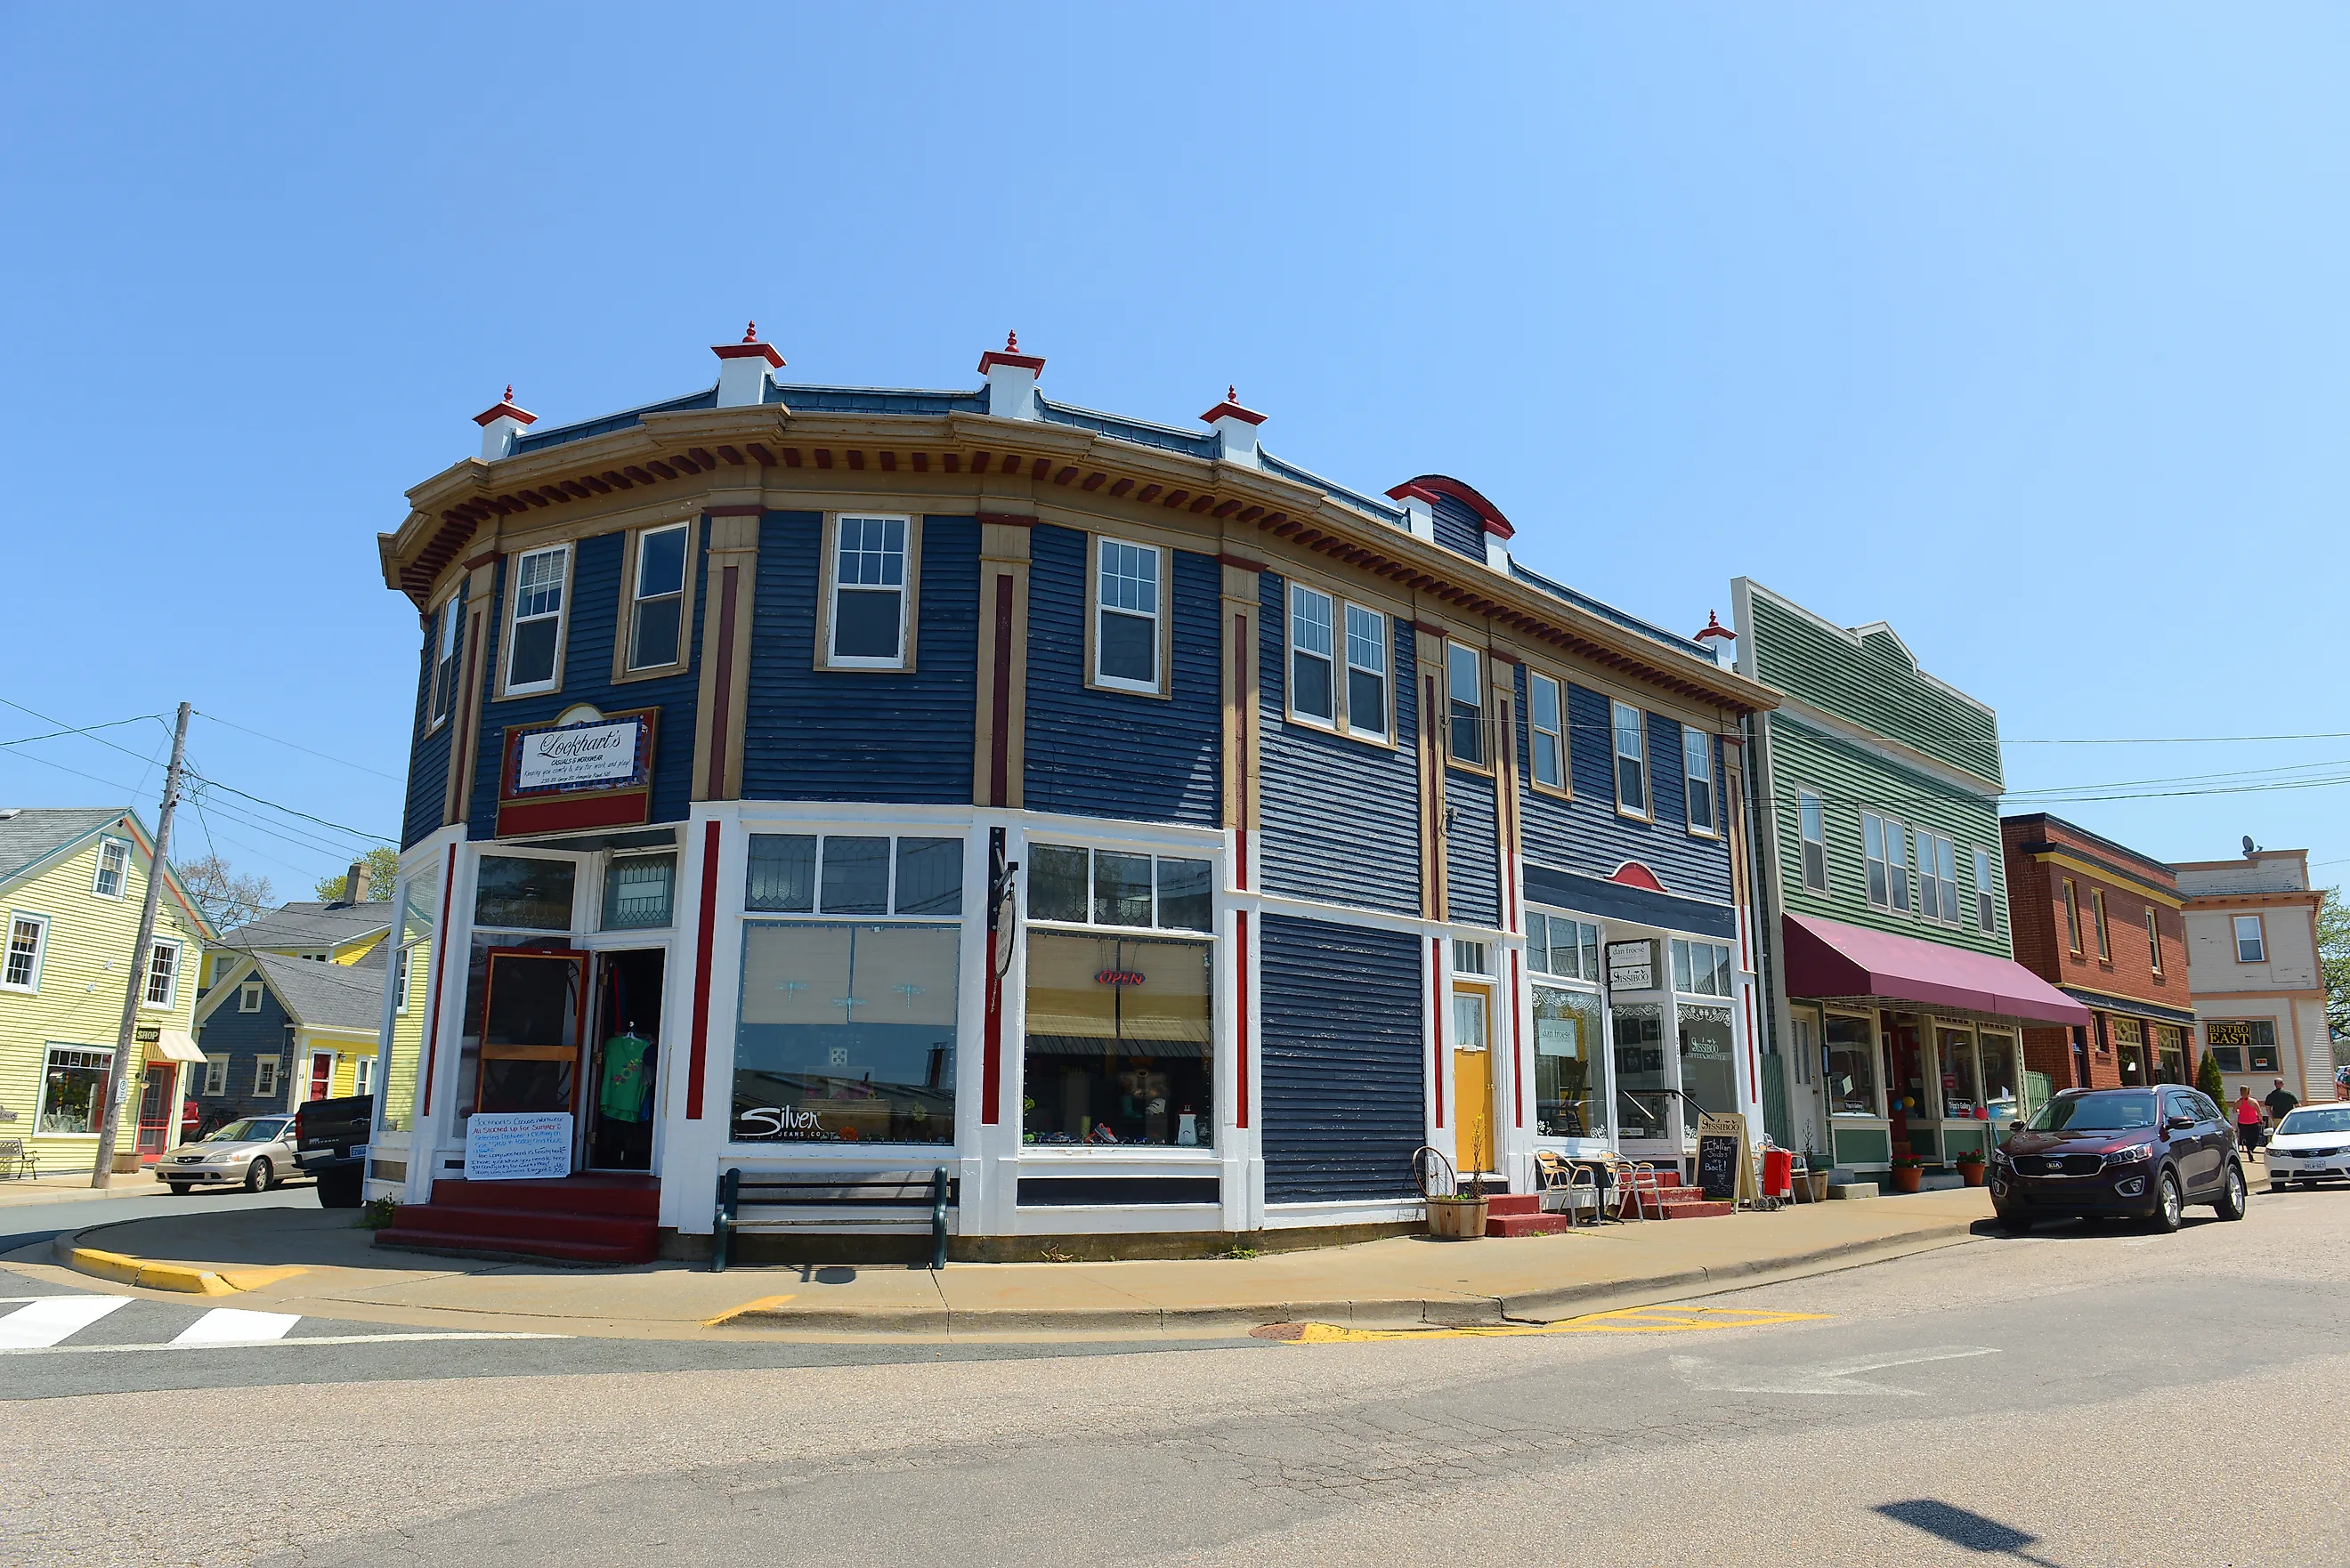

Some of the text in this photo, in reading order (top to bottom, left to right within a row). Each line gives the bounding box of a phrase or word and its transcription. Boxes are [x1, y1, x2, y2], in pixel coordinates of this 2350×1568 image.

[537, 730, 621, 758] Lockhart's
[551, 757, 572, 766] CASUALS
[577, 755, 604, 764] WORKWEAR
[1613, 947, 1625, 955] dan
[1098, 969, 1143, 984] OPEN
[1613, 972, 1649, 983] SISSIBOO
[1542, 1029, 1552, 1038] dan
[2209, 1025, 2249, 1033] BISTRO
[137, 1031, 158, 1039] SHOP
[2209, 1032, 2249, 1045] EAST
[1691, 1037, 1719, 1054] SISSIBOO
[735, 1104, 824, 1136] Silver
[1702, 1119, 1739, 1130] SISSIBOO
[1703, 1139, 1731, 1154] Italian
[1707, 1150, 1728, 1158] Sodas
[1705, 1160, 1727, 1171] Back!
